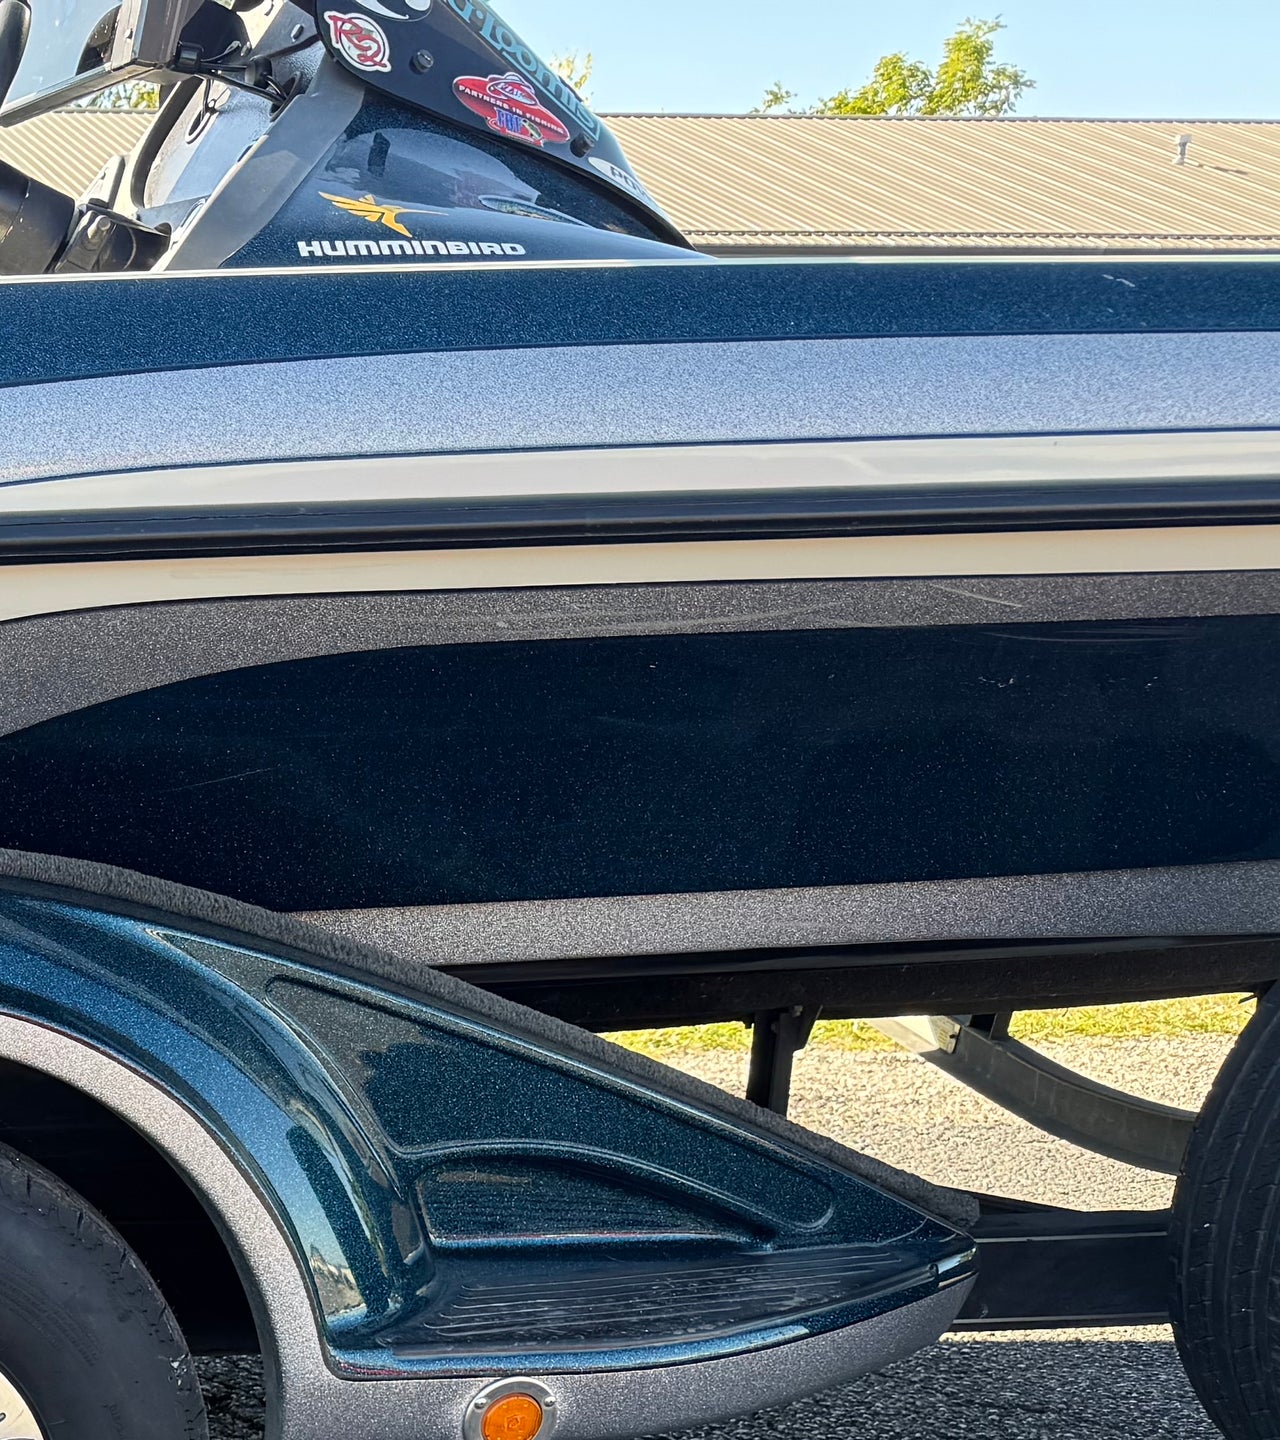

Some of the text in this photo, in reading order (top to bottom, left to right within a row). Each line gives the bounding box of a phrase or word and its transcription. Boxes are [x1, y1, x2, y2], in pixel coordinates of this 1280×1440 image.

[458, 84, 565, 134] PARTNERS IN FISHING
[297, 240, 527, 257] HUMMINBIRD
